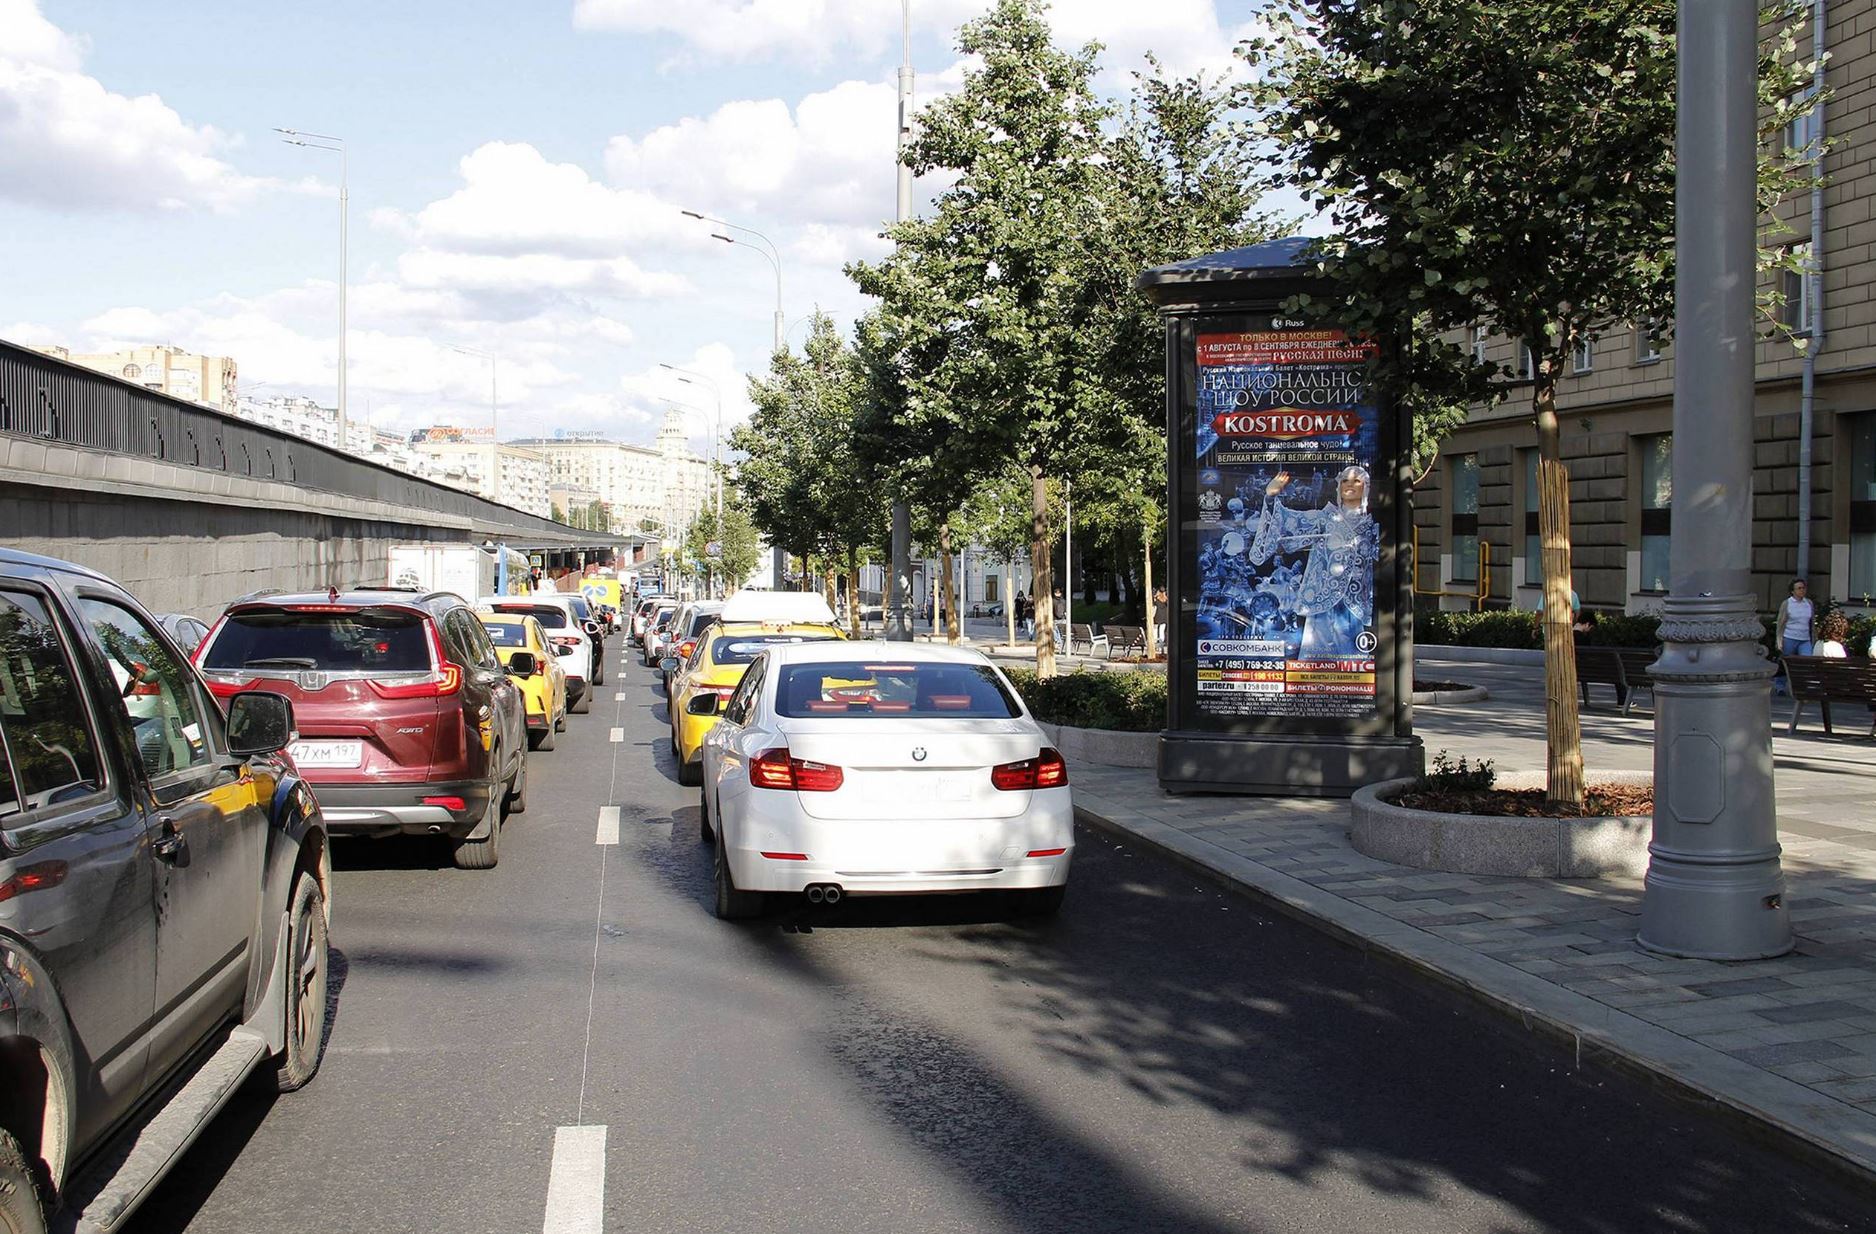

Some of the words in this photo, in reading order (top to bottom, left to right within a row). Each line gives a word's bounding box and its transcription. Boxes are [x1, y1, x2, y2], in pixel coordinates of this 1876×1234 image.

[1285, 319, 1304, 327] Russ
[1240, 333, 1277, 341] ТОЛЬКО
[1280, 332, 1287, 340] В
[1289, 331, 1332, 340] МОСКВЕ!
[1209, 343, 1241, 352] АВГУСТА
[1261, 341, 1299, 350] СЕНТЯБРЯ
[1301, 340, 1343, 349] ЕЖЕДНЕ
[1273, 351, 1324, 362] РУССКАЯ
[1203, 371, 1362, 390] НАЦИОНАЛЬНО
[1214, 390, 1264, 407] ШОУ
[1270, 388, 1358, 405] РОССИИ
[1225, 415, 1348, 433] KOSTROMA
[1231, 441, 1263, 450] Русское
[1265, 441, 1318, 449] танцевальное
[1320, 440, 1343, 448] чудо!
[1218, 454, 1250, 462] ВЕЛИКАЯ
[1288, 453, 1322, 461] ВЕЛИКОЙ
[1324, 453, 1354, 461] СТРАНЫ
[1359, 636, 1374, 648] 0+
[1213, 643, 1281, 653] СОВКОМБАНК
[1225, 660, 1244, 669] (495)
[1246, 661, 1284, 670] 769-32-35
[1202, 682, 1235, 690] parter.ru
[334, 745, 356, 756] 197
